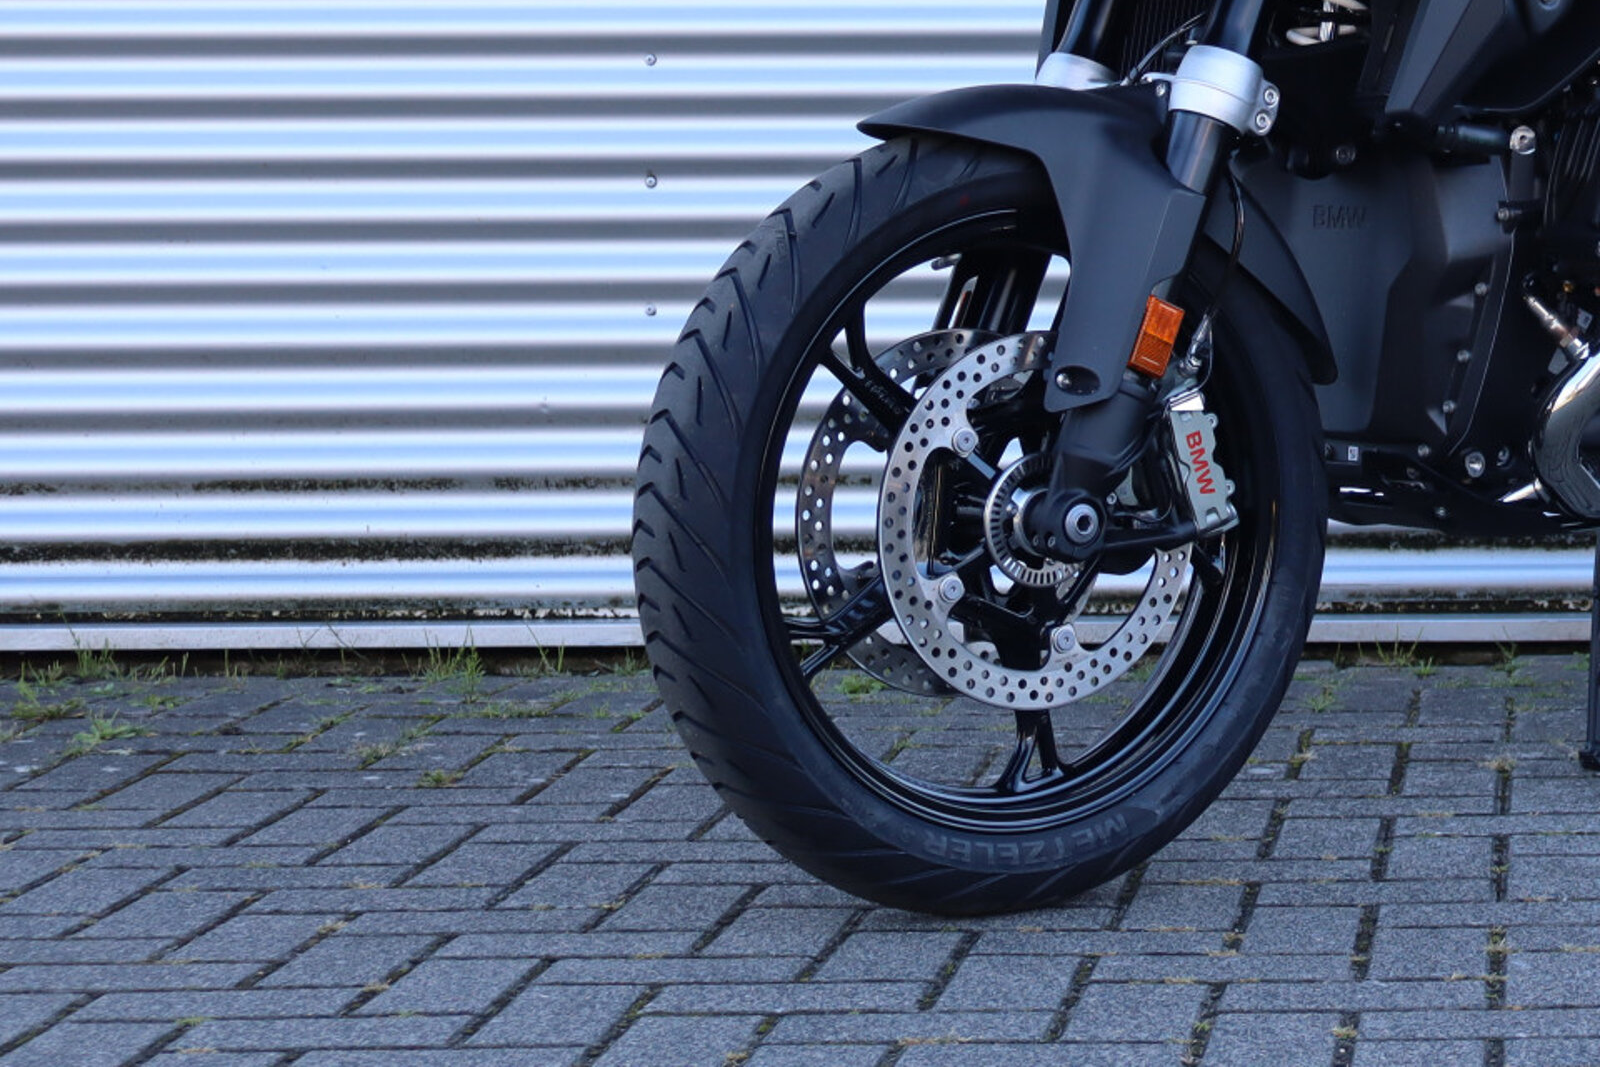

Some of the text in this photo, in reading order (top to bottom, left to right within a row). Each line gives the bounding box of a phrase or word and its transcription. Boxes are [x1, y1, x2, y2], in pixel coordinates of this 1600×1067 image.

[1312, 204, 1367, 229] BMW
[1185, 430, 1216, 495] BMW
[921, 812, 1129, 866] METZELER
